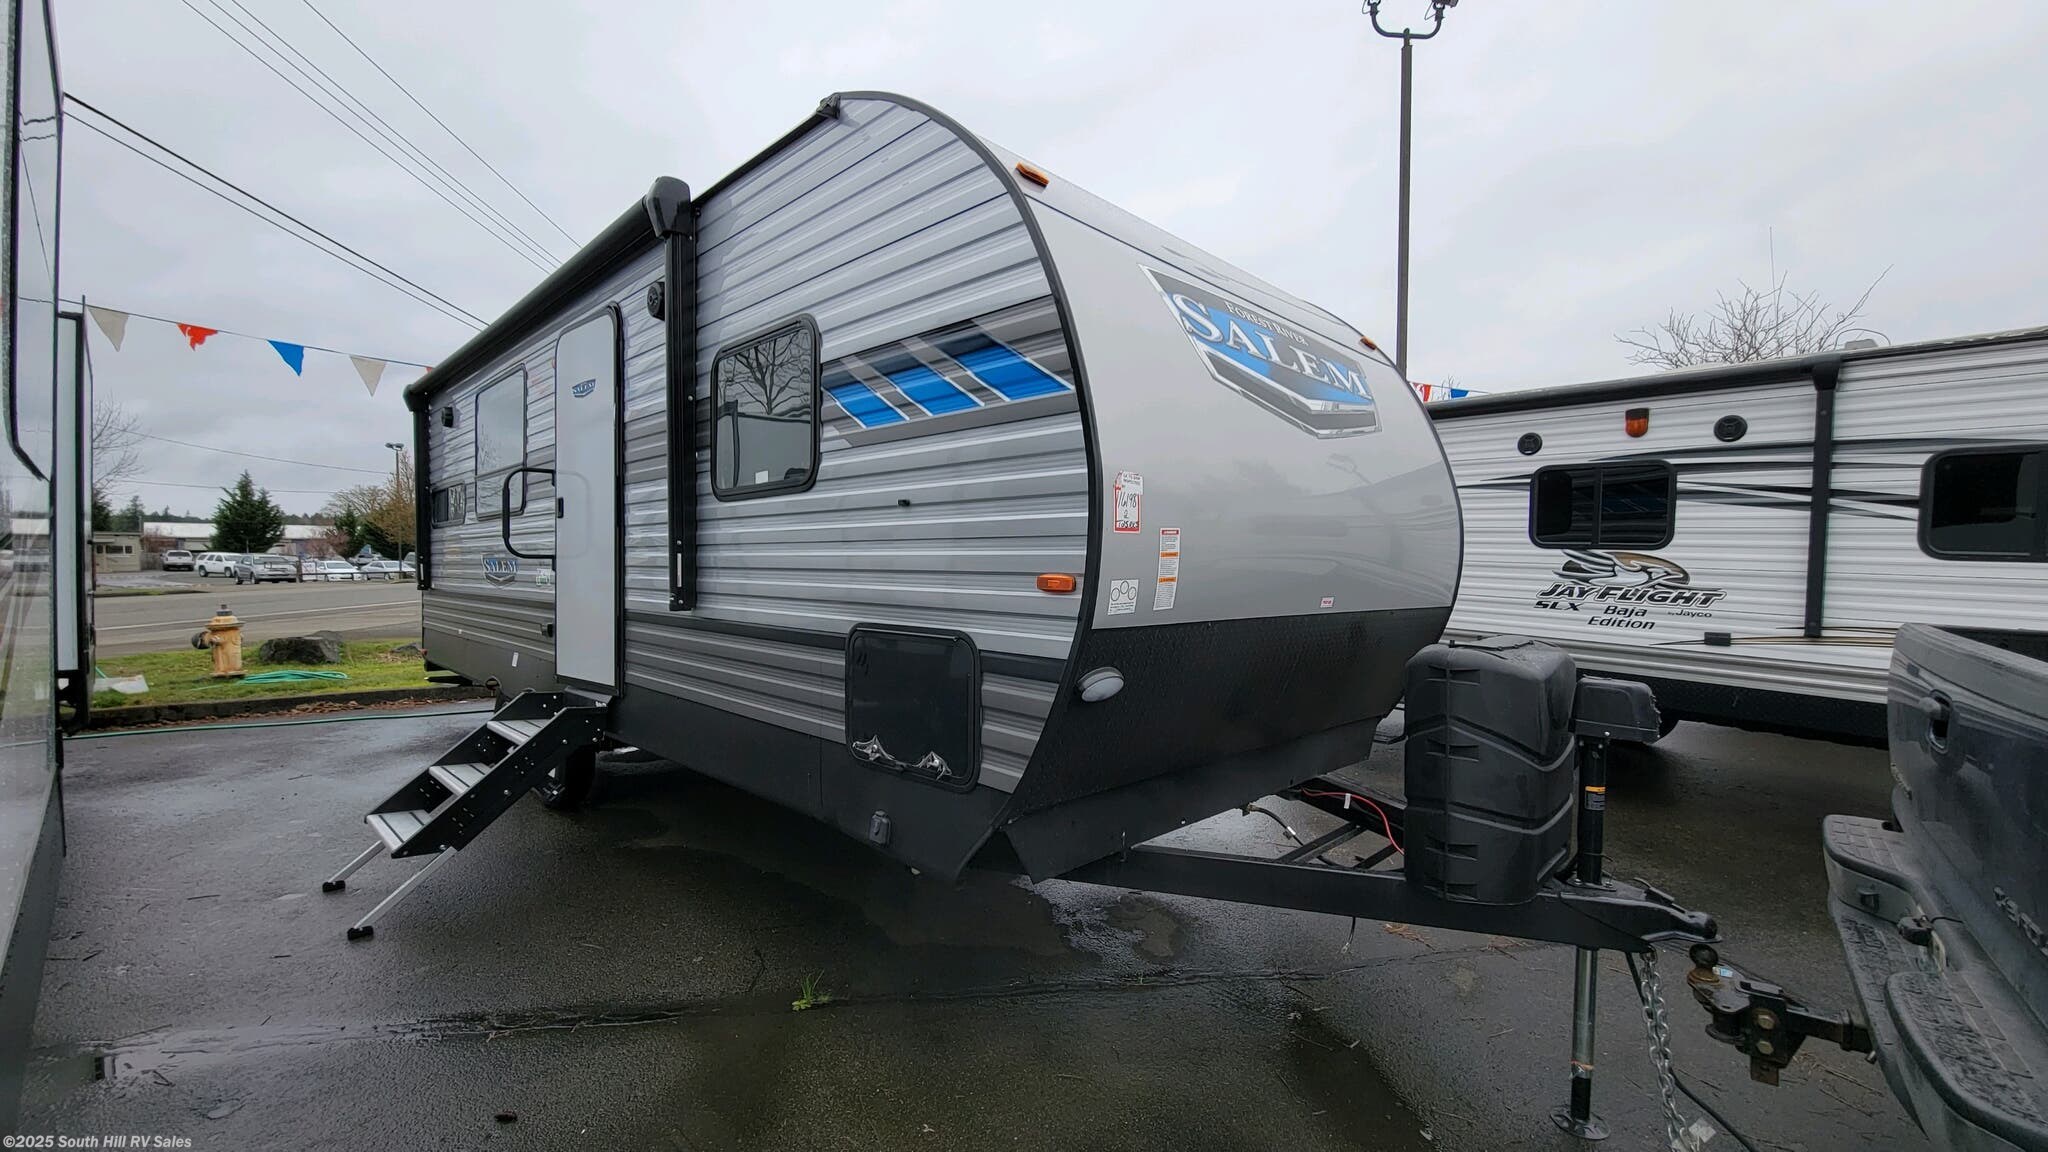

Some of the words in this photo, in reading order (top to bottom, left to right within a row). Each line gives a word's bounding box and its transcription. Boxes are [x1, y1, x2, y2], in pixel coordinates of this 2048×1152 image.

[1172, 293, 1373, 400] SALEM
[483, 558, 519, 573] SALEM
[1536, 583, 1598, 600] JAY
[1595, 584, 1727, 608] FLIGHT
[1534, 600, 1586, 612] SLX
[1603, 605, 1648, 618] Baja
[1675, 609, 1712, 618] Jayco
[1587, 616, 1656, 630] Edition
